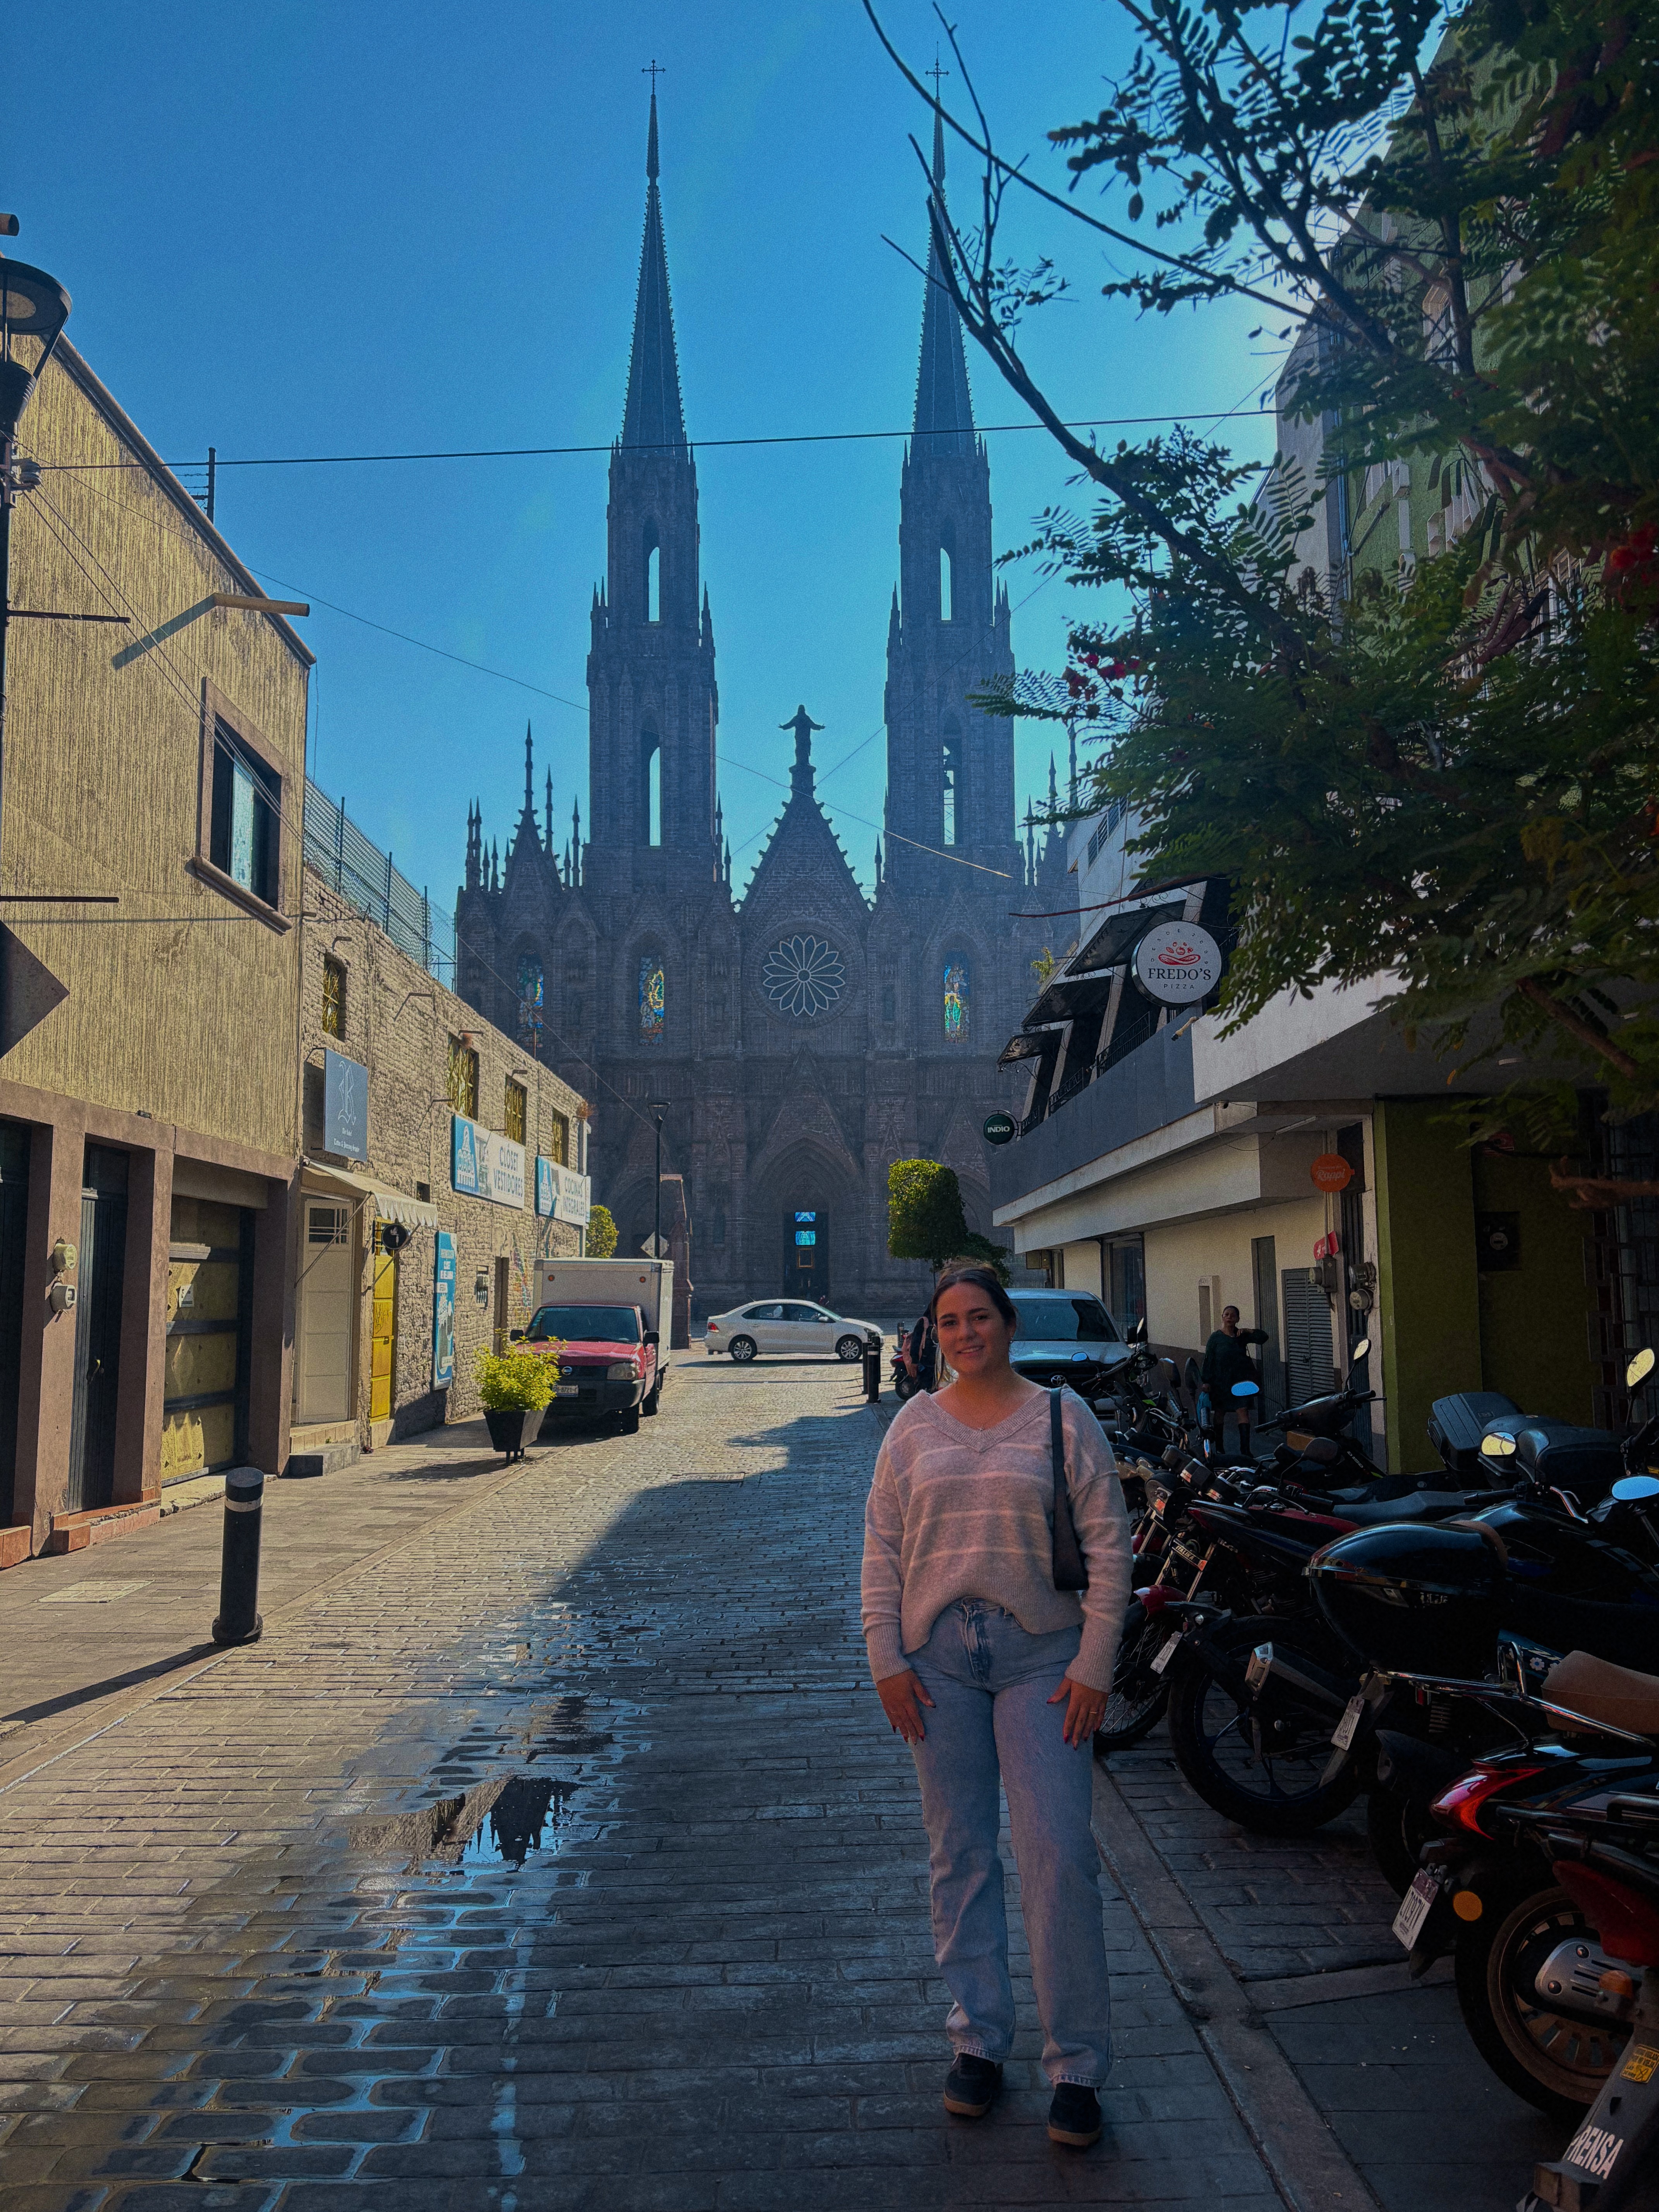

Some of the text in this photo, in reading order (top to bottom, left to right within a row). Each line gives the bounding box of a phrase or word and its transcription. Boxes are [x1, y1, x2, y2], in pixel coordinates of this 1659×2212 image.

[1151, 929, 1181, 962] DESDE
[1148, 968, 1211, 980] FREDO'S
[499, 1143, 519, 1172] CLÓSET
[493, 1168, 524, 1198] VESTIDORES
[1316, 1169, 1345, 1181] Rappi
[564, 1176, 583, 1198] COCINAS
[563, 1195, 584, 1217] INTEGRALES
[1175, 1545, 1195, 1561] ITALIKA
[1562, 2125, 1624, 2179] PRENSA
